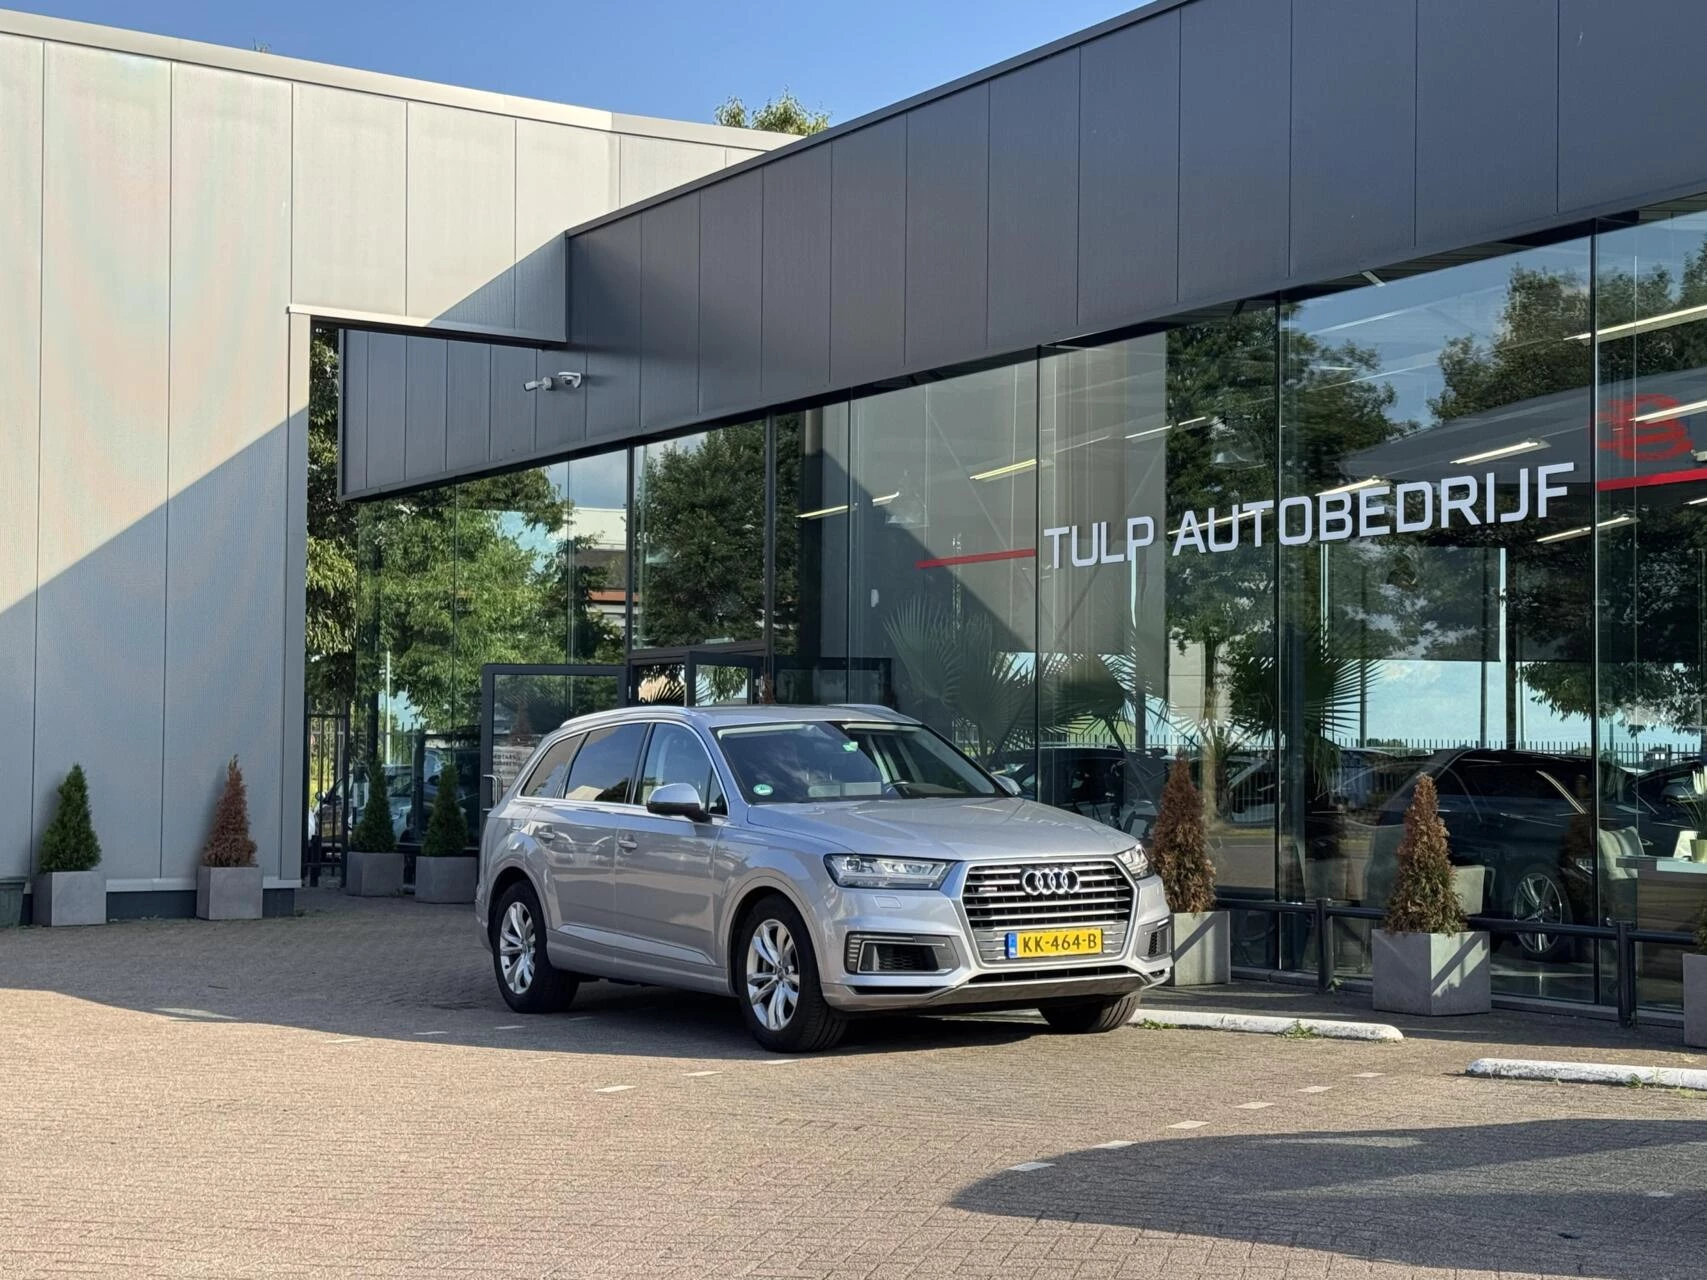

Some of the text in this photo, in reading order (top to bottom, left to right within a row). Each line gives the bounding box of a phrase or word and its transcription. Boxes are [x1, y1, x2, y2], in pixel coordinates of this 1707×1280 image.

[1044, 462, 1575, 569] TULP AUTOBEDRIJF
[1023, 933, 1097, 953] KK-464-B
